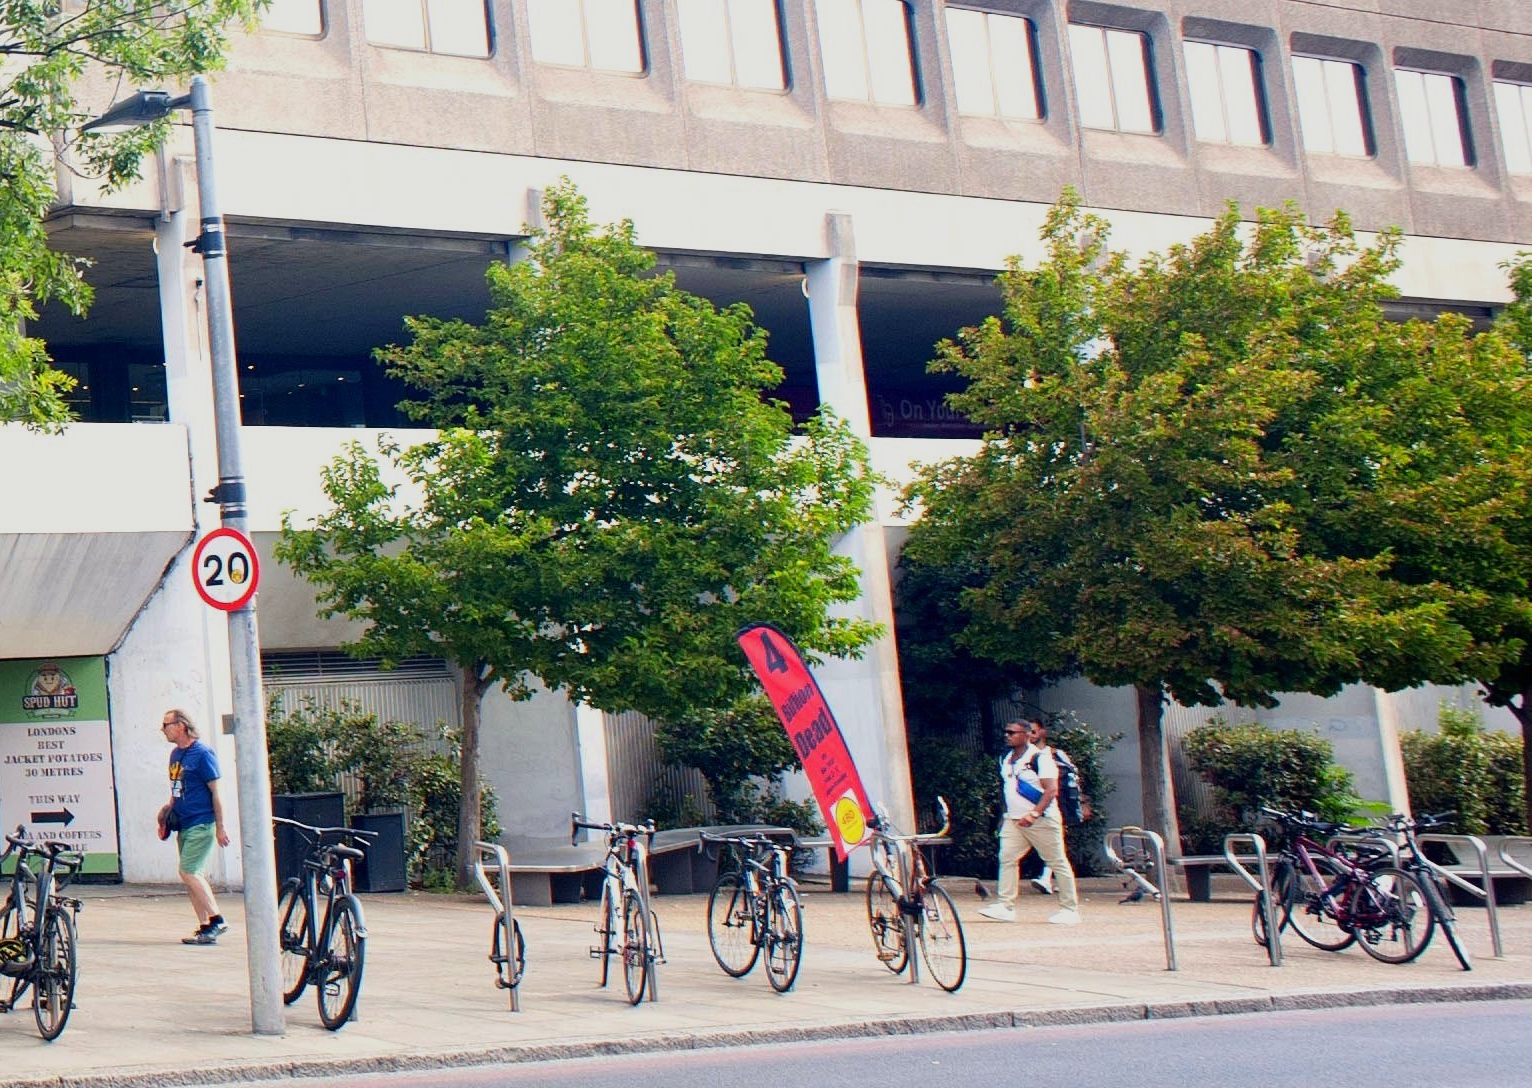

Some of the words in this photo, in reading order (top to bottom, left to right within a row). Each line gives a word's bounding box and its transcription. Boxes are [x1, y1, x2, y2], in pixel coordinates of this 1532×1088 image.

[204, 552, 248, 586] 20
[760, 631, 788, 673] 4
[23, 696, 51, 708] SPUD
[54, 695, 77, 708] HUT
[27, 726, 77, 737] LONDONS
[795, 707, 832, 759] Dead
[37, 740, 66, 750] BEST
[4, 754, 45, 764] JACKET
[48, 752, 103, 763] POTATOES
[25, 768, 38, 777] 30
[40, 767, 84, 777] METRES
[28, 795, 55, 805] THIS
[57, 794, 81, 804] WAY
[36, 831, 56, 840] AND
